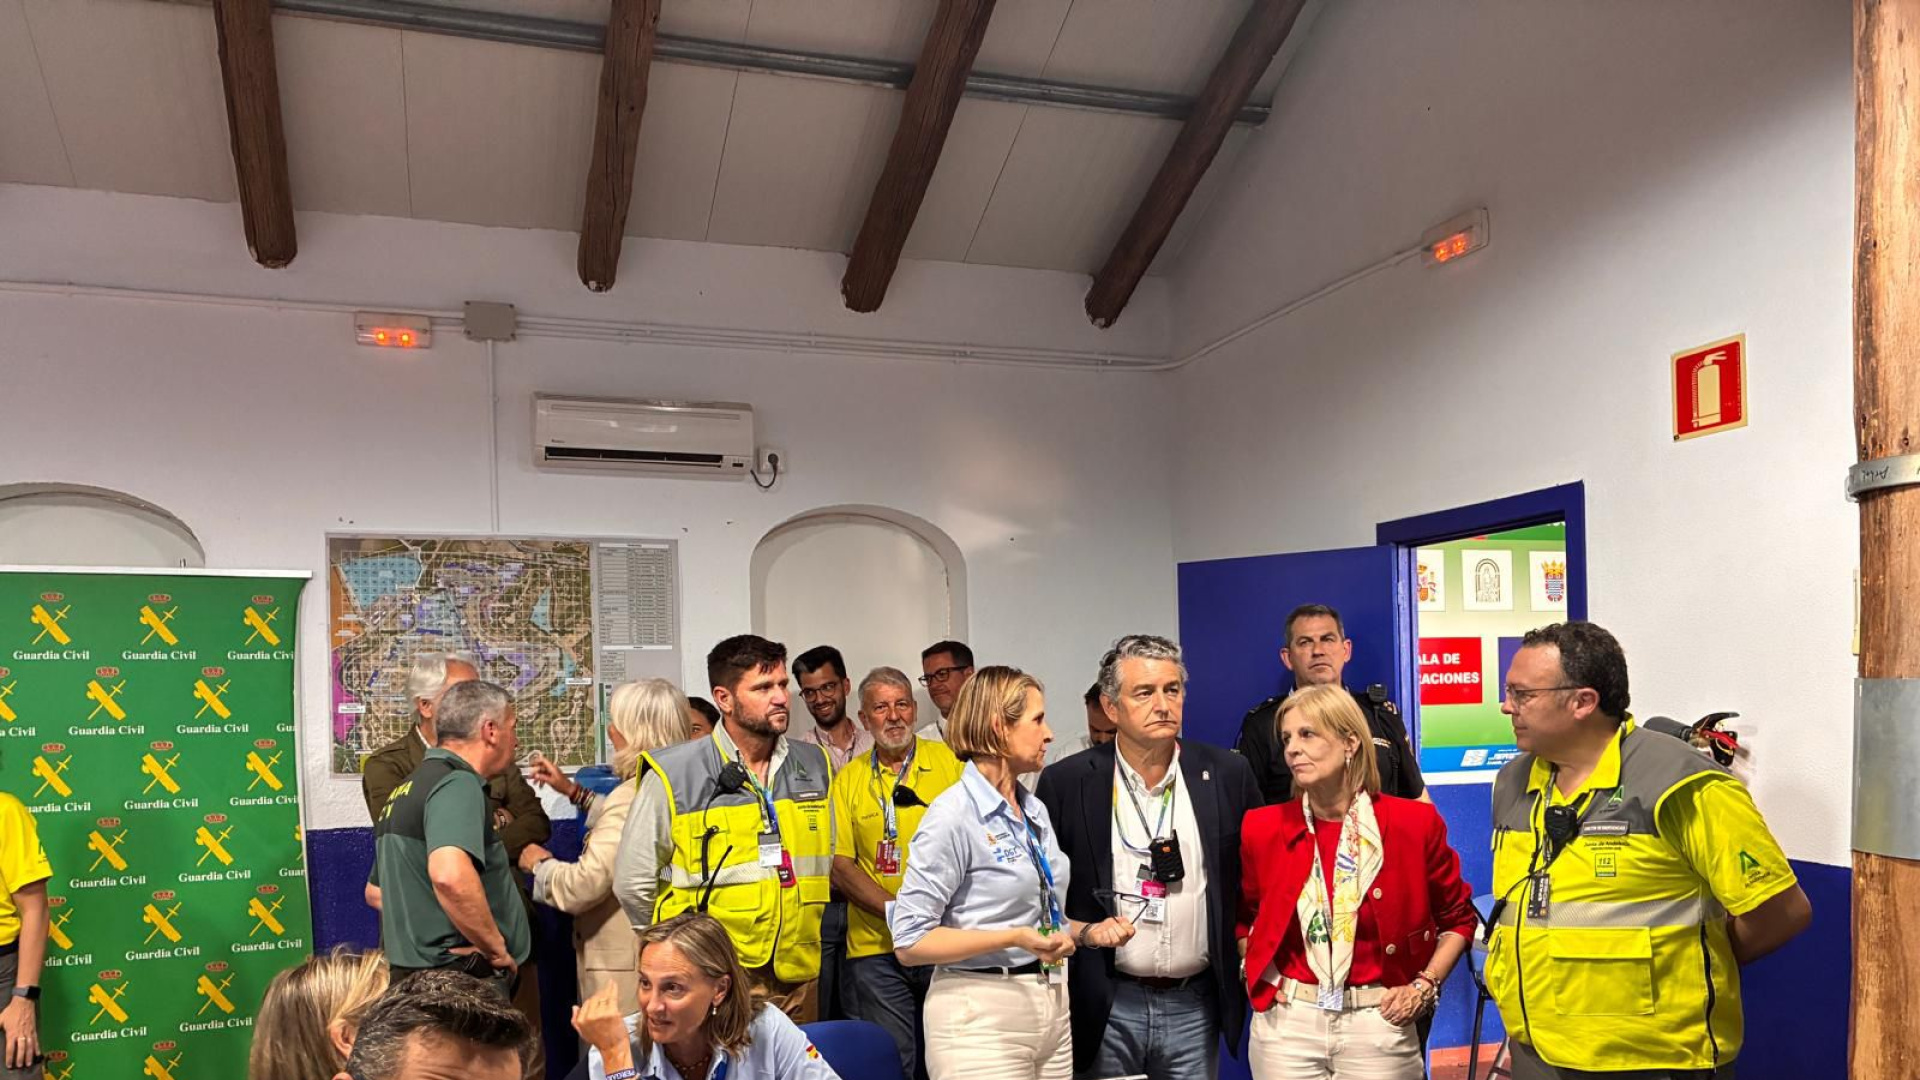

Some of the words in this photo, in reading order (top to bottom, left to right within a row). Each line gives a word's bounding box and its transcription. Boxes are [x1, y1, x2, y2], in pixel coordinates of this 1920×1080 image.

[13, 650, 61, 661] Guardia
[63, 650, 90, 660] Civil
[122, 650, 168, 661] Guardia
[170, 650, 197, 660] Civil
[227, 650, 271, 660] Guardia
[273, 650, 294, 660] Civi
[1443, 652, 1461, 665] DE
[1420, 671, 1480, 685] ACIONES
[8, 726, 36, 737] Civil
[68, 725, 116, 736] Guardia
[119, 725, 145, 735] Civil
[176, 723, 222, 734] Guardia
[224, 723, 249, 733] Civil
[124, 799, 170, 810] Guardia
[172, 797, 199, 809] Civil
[229, 796, 273, 806] Guardia
[275, 794, 297, 805] Civi
[24, 803, 62, 813] uardia
[64, 801, 91, 812] Civil
[69, 877, 117, 889] Guardia
[119, 875, 146, 886] Civil
[178, 871, 224, 883] Guardia
[226, 870, 251, 880] Civil
[231, 941, 276, 953] Guardia
[277, 939, 302, 949] Civil
[65, 953, 92, 966] Civil
[125, 948, 172, 961] Guardia
[174, 946, 200, 957] Civil
[179, 1019, 224, 1033] Guardia
[226, 1017, 253, 1029] Civil
[71, 1029, 118, 1042] Guardia
[120, 1026, 147, 1039] Civil
